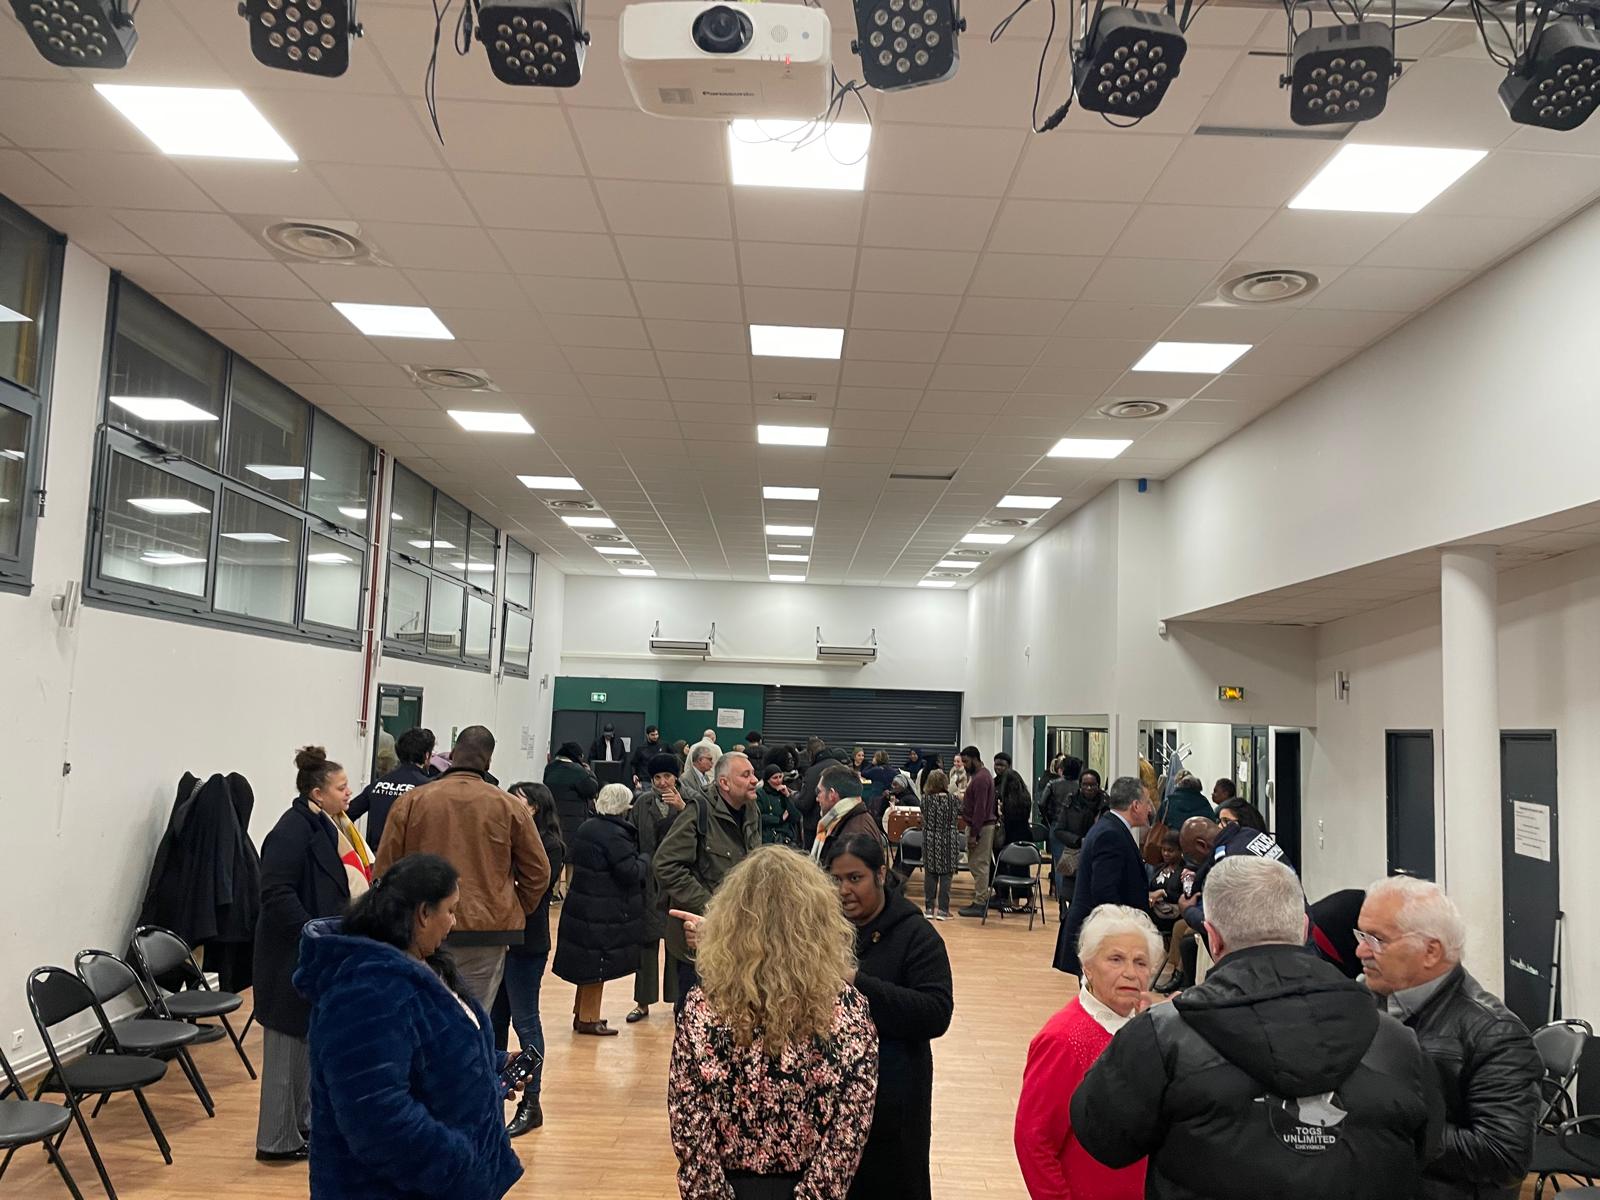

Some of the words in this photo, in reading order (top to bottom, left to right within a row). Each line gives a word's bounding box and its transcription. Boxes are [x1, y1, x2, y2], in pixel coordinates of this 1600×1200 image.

[374, 781, 416, 792] POLICE
[372, 789, 404, 797] NATIONA
[1295, 1126, 1323, 1136] TOGS
[1283, 1134, 1337, 1145] UNLIMITED
